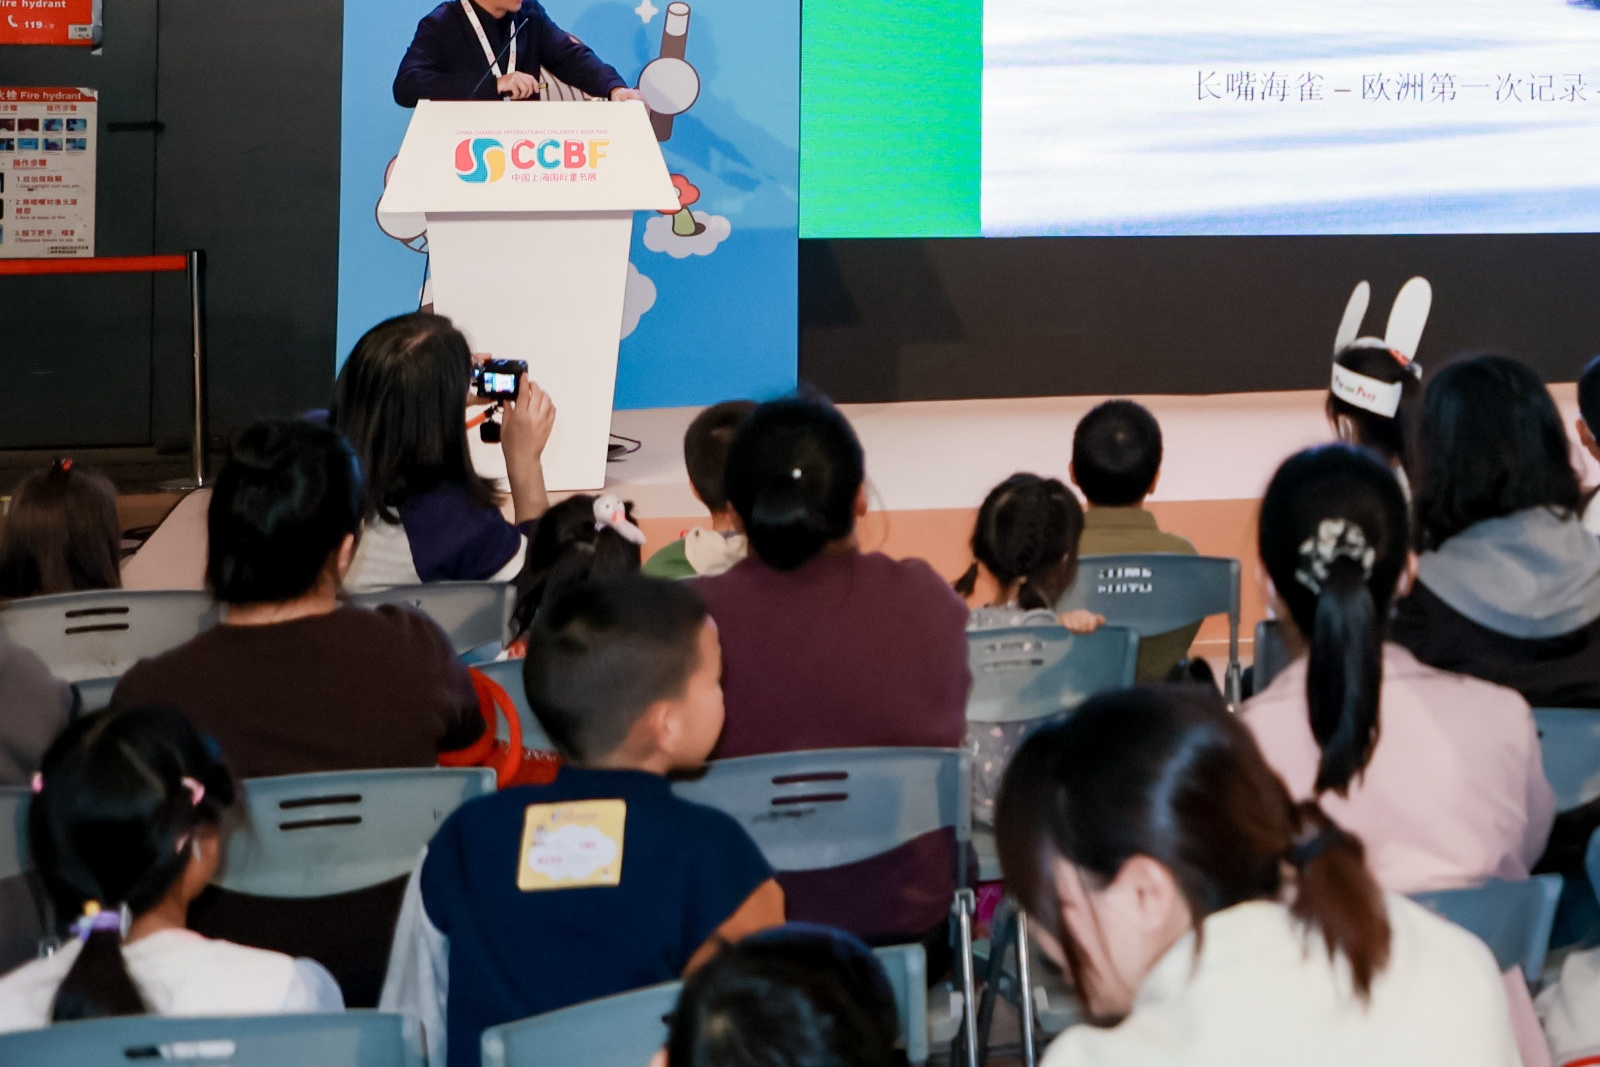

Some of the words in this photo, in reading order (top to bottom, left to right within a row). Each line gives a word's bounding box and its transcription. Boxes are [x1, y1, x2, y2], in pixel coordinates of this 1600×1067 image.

[22, 0, 66, 9] hydrant
[24, 21, 43, 29] 119
[1192, 70, 1325, 103] 长嘴海雀
[1361, 71, 1589, 104] 欧洲第一次记录
[21, 92, 40, 100] Fire
[511, 139, 610, 169] CCBF
[511, 172, 597, 182] 中国上海国际童书展
